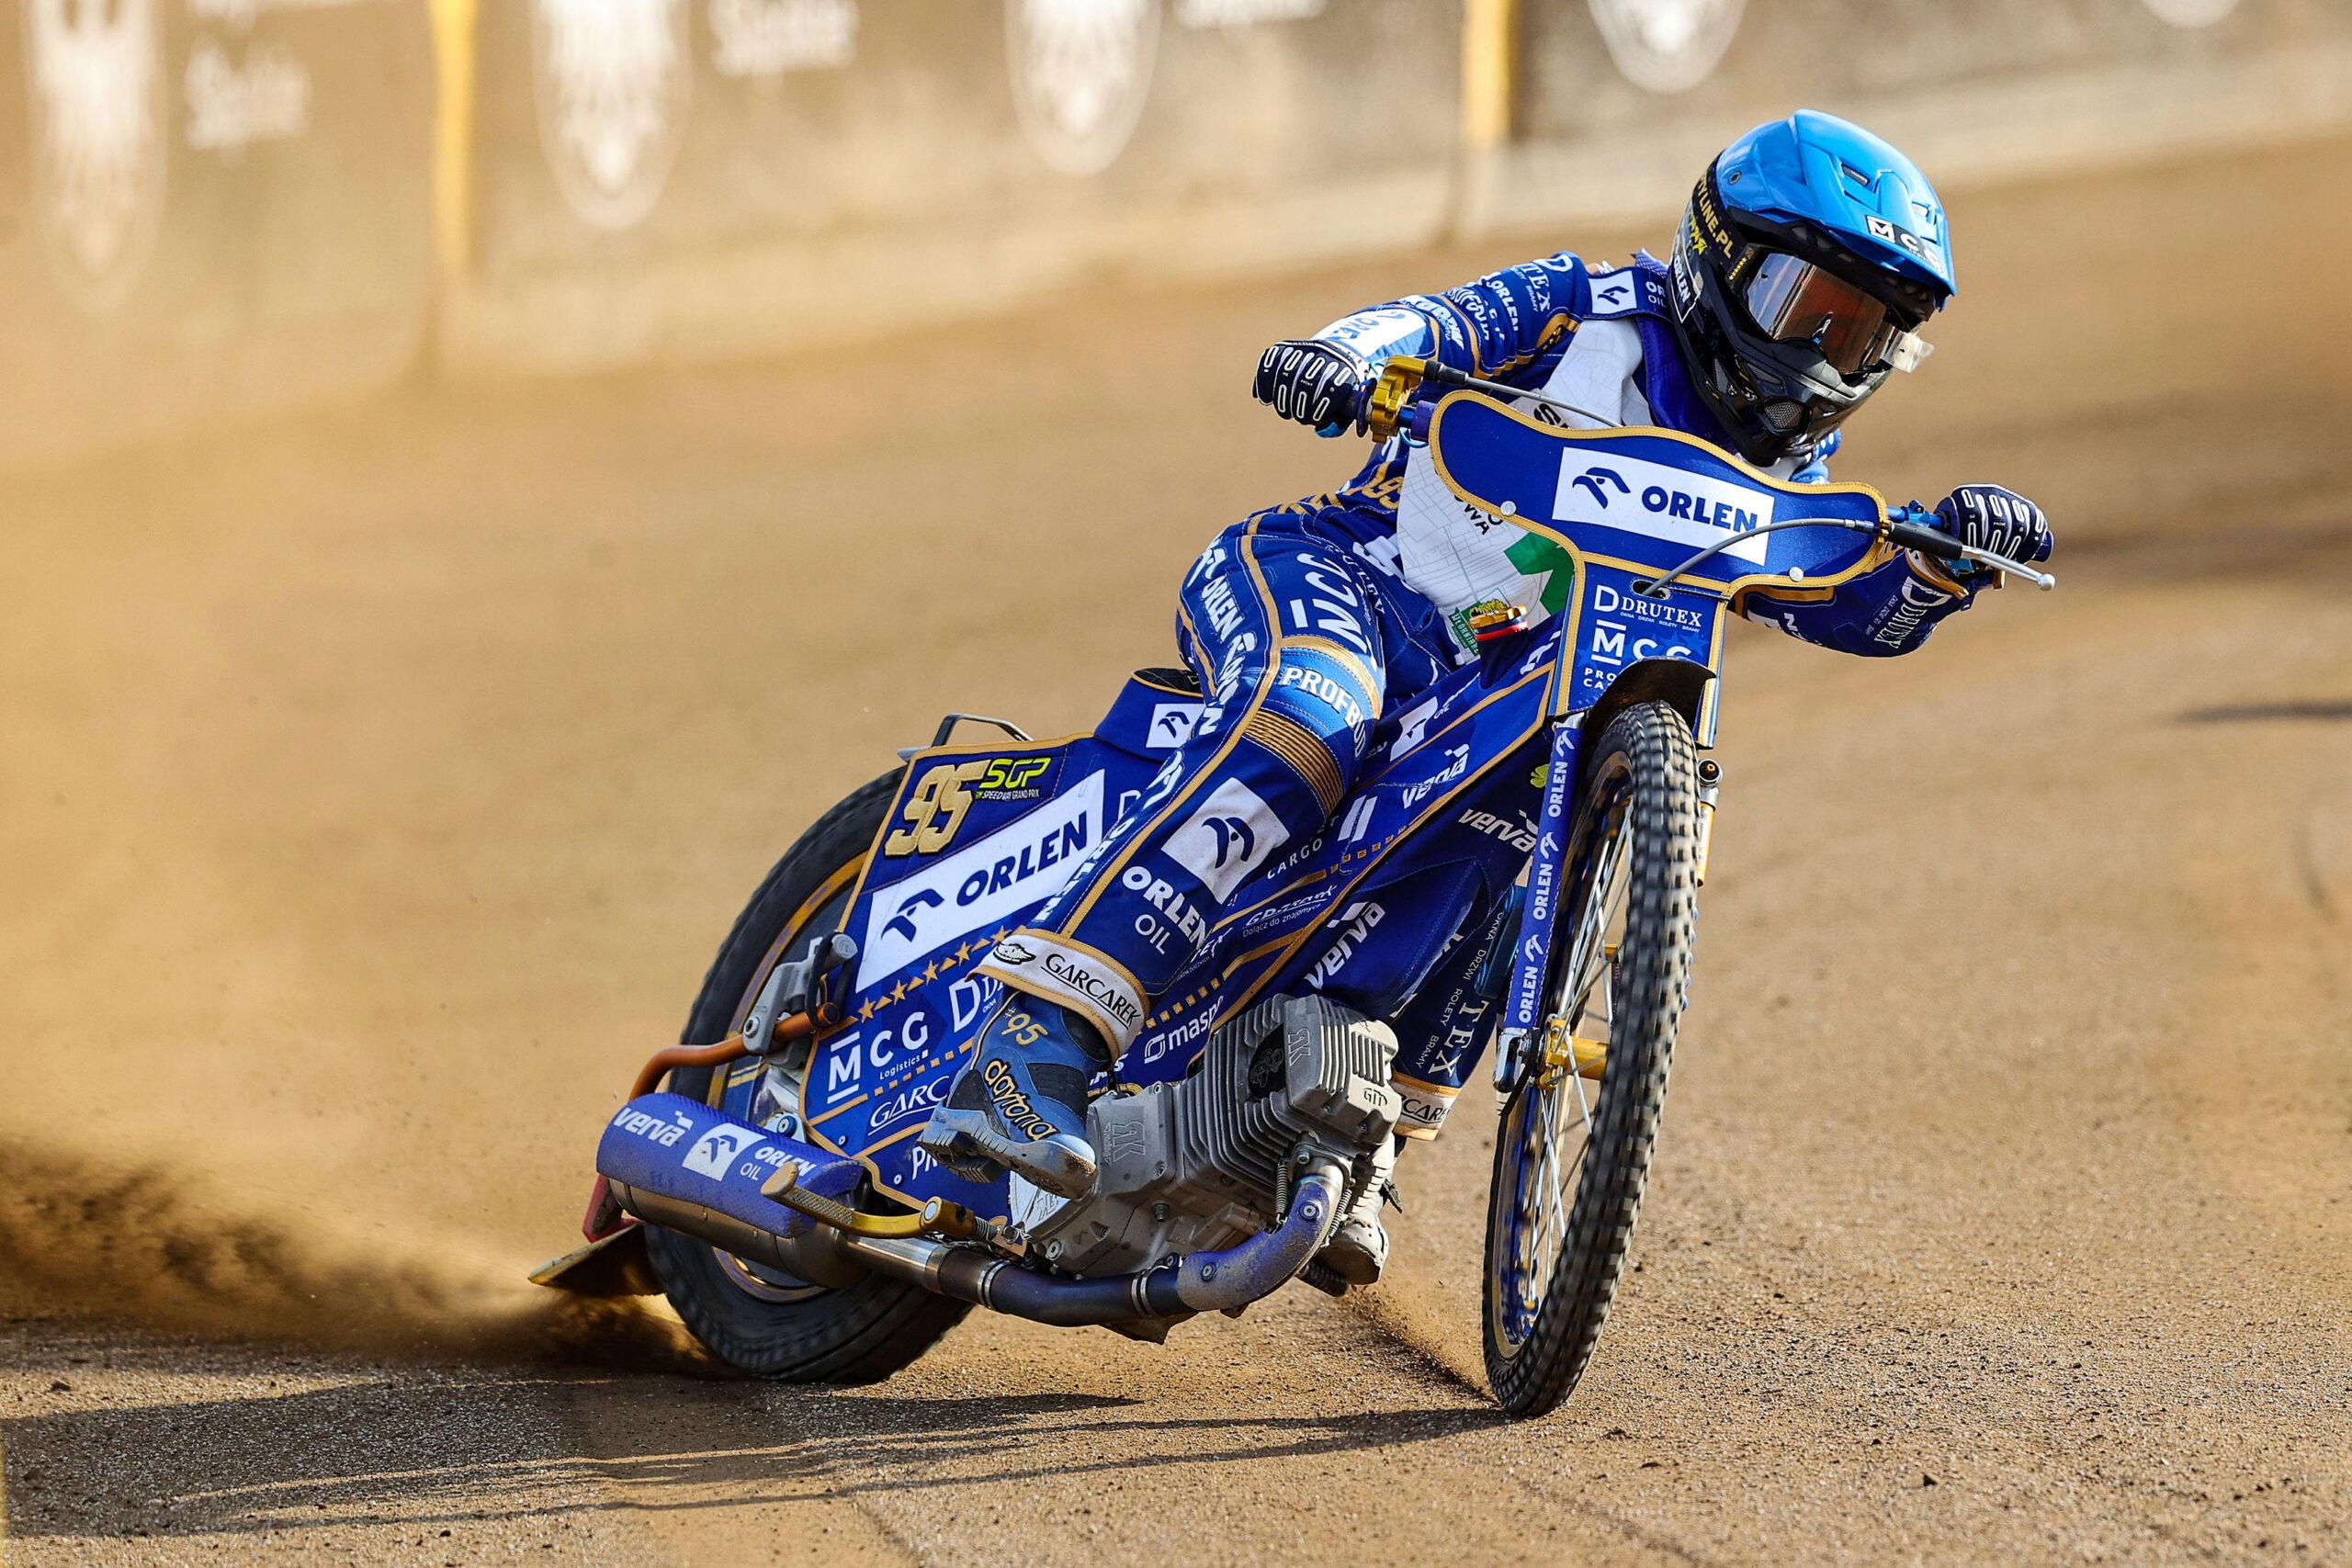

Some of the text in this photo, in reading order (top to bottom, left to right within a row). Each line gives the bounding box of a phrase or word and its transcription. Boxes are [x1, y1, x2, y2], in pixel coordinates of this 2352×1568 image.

[1674, 256, 1691, 304] ORLEN
[1641, 486, 1758, 533] ORLEN
[1201, 573, 1246, 643] ORLEN
[1621, 596, 1702, 627] DRUTEX
[978, 758, 1051, 788] SGP
[1012, 790, 1028, 799] GRAND
[1028, 789, 1040, 798] PRIX
[1547, 761, 1567, 818] ORLEN
[885, 760, 990, 857] 95
[1458, 808, 1539, 853] verva
[956, 810, 1087, 907] ORLEN
[1267, 838, 1323, 879] CARGO
[1122, 865, 1207, 950] ORLEN
[1532, 863, 1554, 921] ORLEN
[1135, 914, 1166, 955] OIL
[1269, 917, 1280, 927] do
[1485, 911, 1504, 942] OKNA
[1304, 901, 1386, 989] verva
[1462, 949, 1487, 982] DRZWI
[1045, 952, 1142, 1029] GARCAREK
[1440, 987, 1464, 1027] ROLETY
[1518, 965, 1539, 1023] ORLEN
[827, 1011, 930, 1104] MCG
[879, 1055, 922, 1081] Logistics
[1416, 1034, 1440, 1069] BRAMY
[869, 1075, 950, 1130] GARC
[984, 1058, 1060, 1142] daytona
[613, 1106, 687, 1148] verva
[740, 1161, 761, 1181] OIL
[754, 1145, 817, 1177] ORLEN
